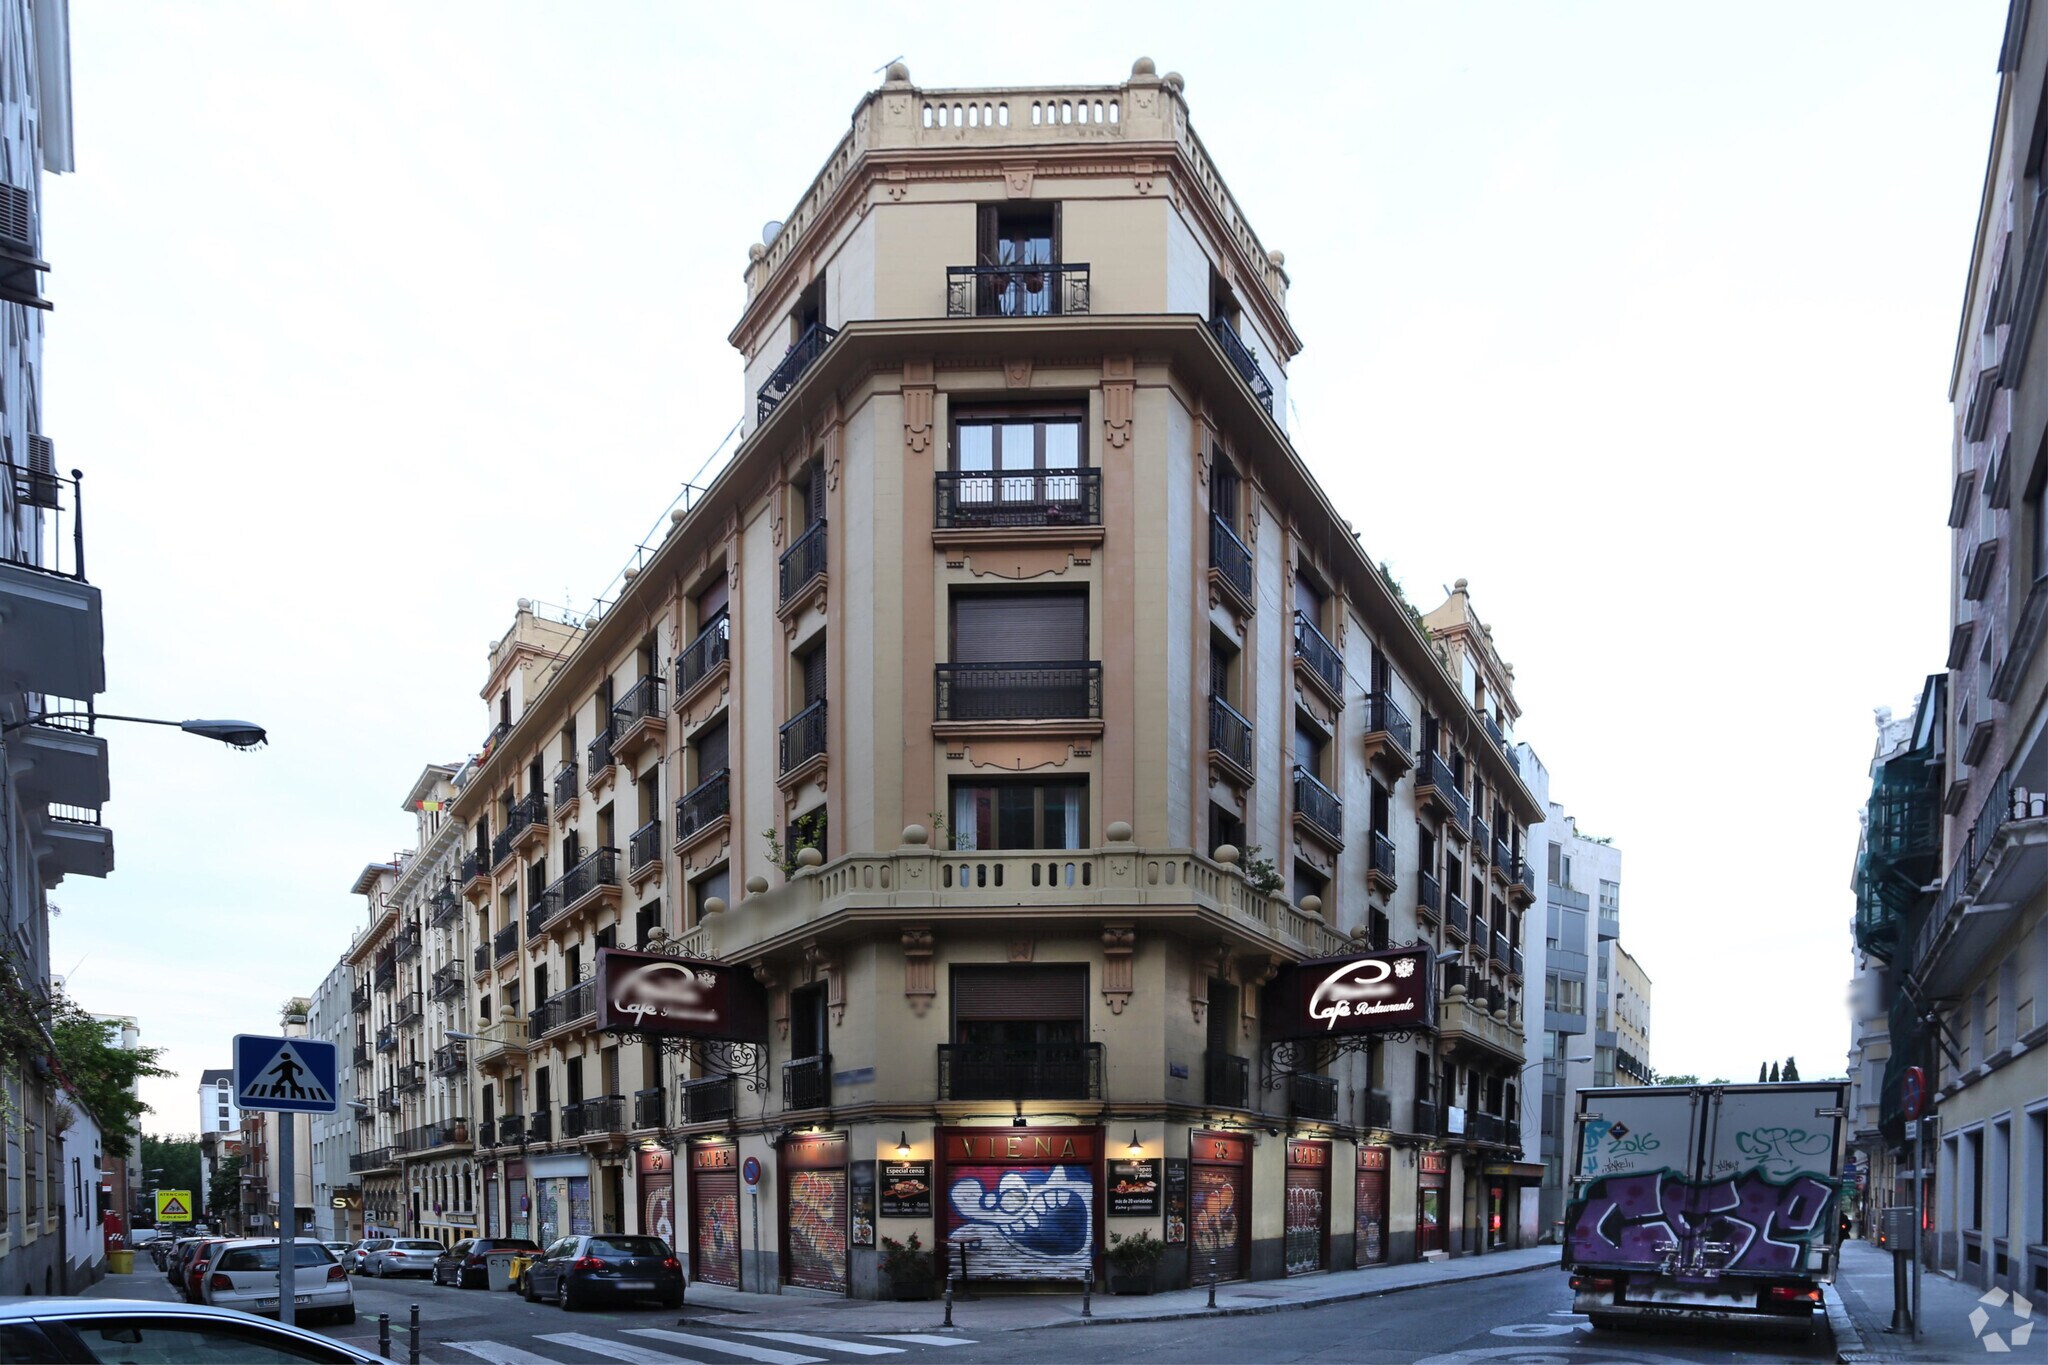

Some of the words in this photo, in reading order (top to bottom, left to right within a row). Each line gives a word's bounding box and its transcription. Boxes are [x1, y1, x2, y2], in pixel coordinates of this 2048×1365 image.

[1354, 998, 1414, 1015] Restaurante
[961, 1136, 1076, 1158] VIENA
[1608, 1133, 1660, 1153] 2016
[1361, 1151, 1384, 1167] BAR
[333, 1198, 361, 1208] SV
